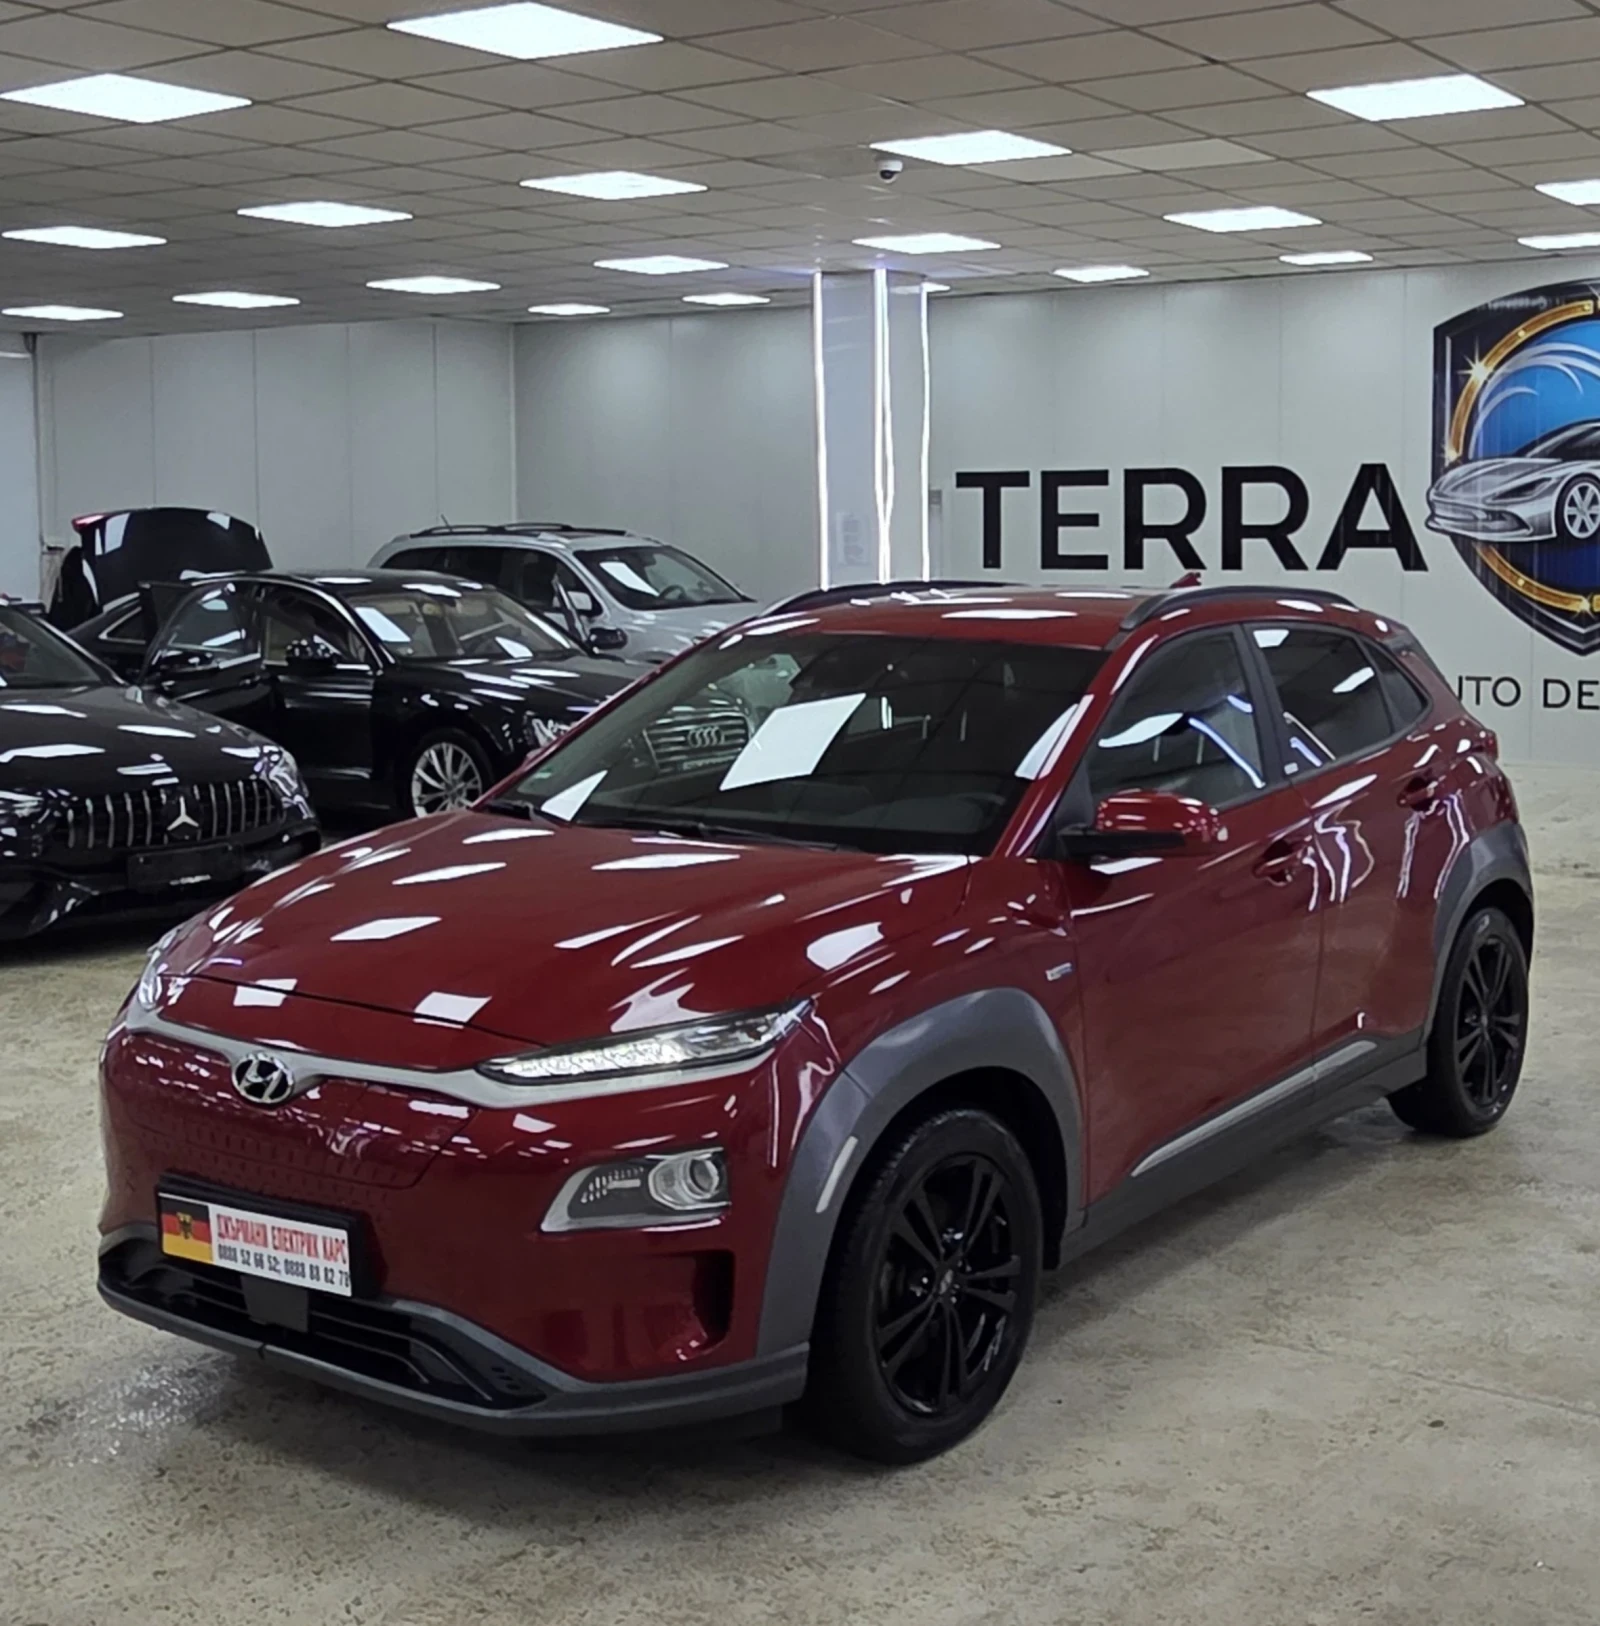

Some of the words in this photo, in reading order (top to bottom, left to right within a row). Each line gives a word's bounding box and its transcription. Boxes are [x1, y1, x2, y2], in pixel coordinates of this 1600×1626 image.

[955, 463, 1429, 571] TERRA
[1543, 678, 1600, 710] DE
[240, 1248, 250, 1266] 52
[323, 1235, 347, 1264] КАРС
